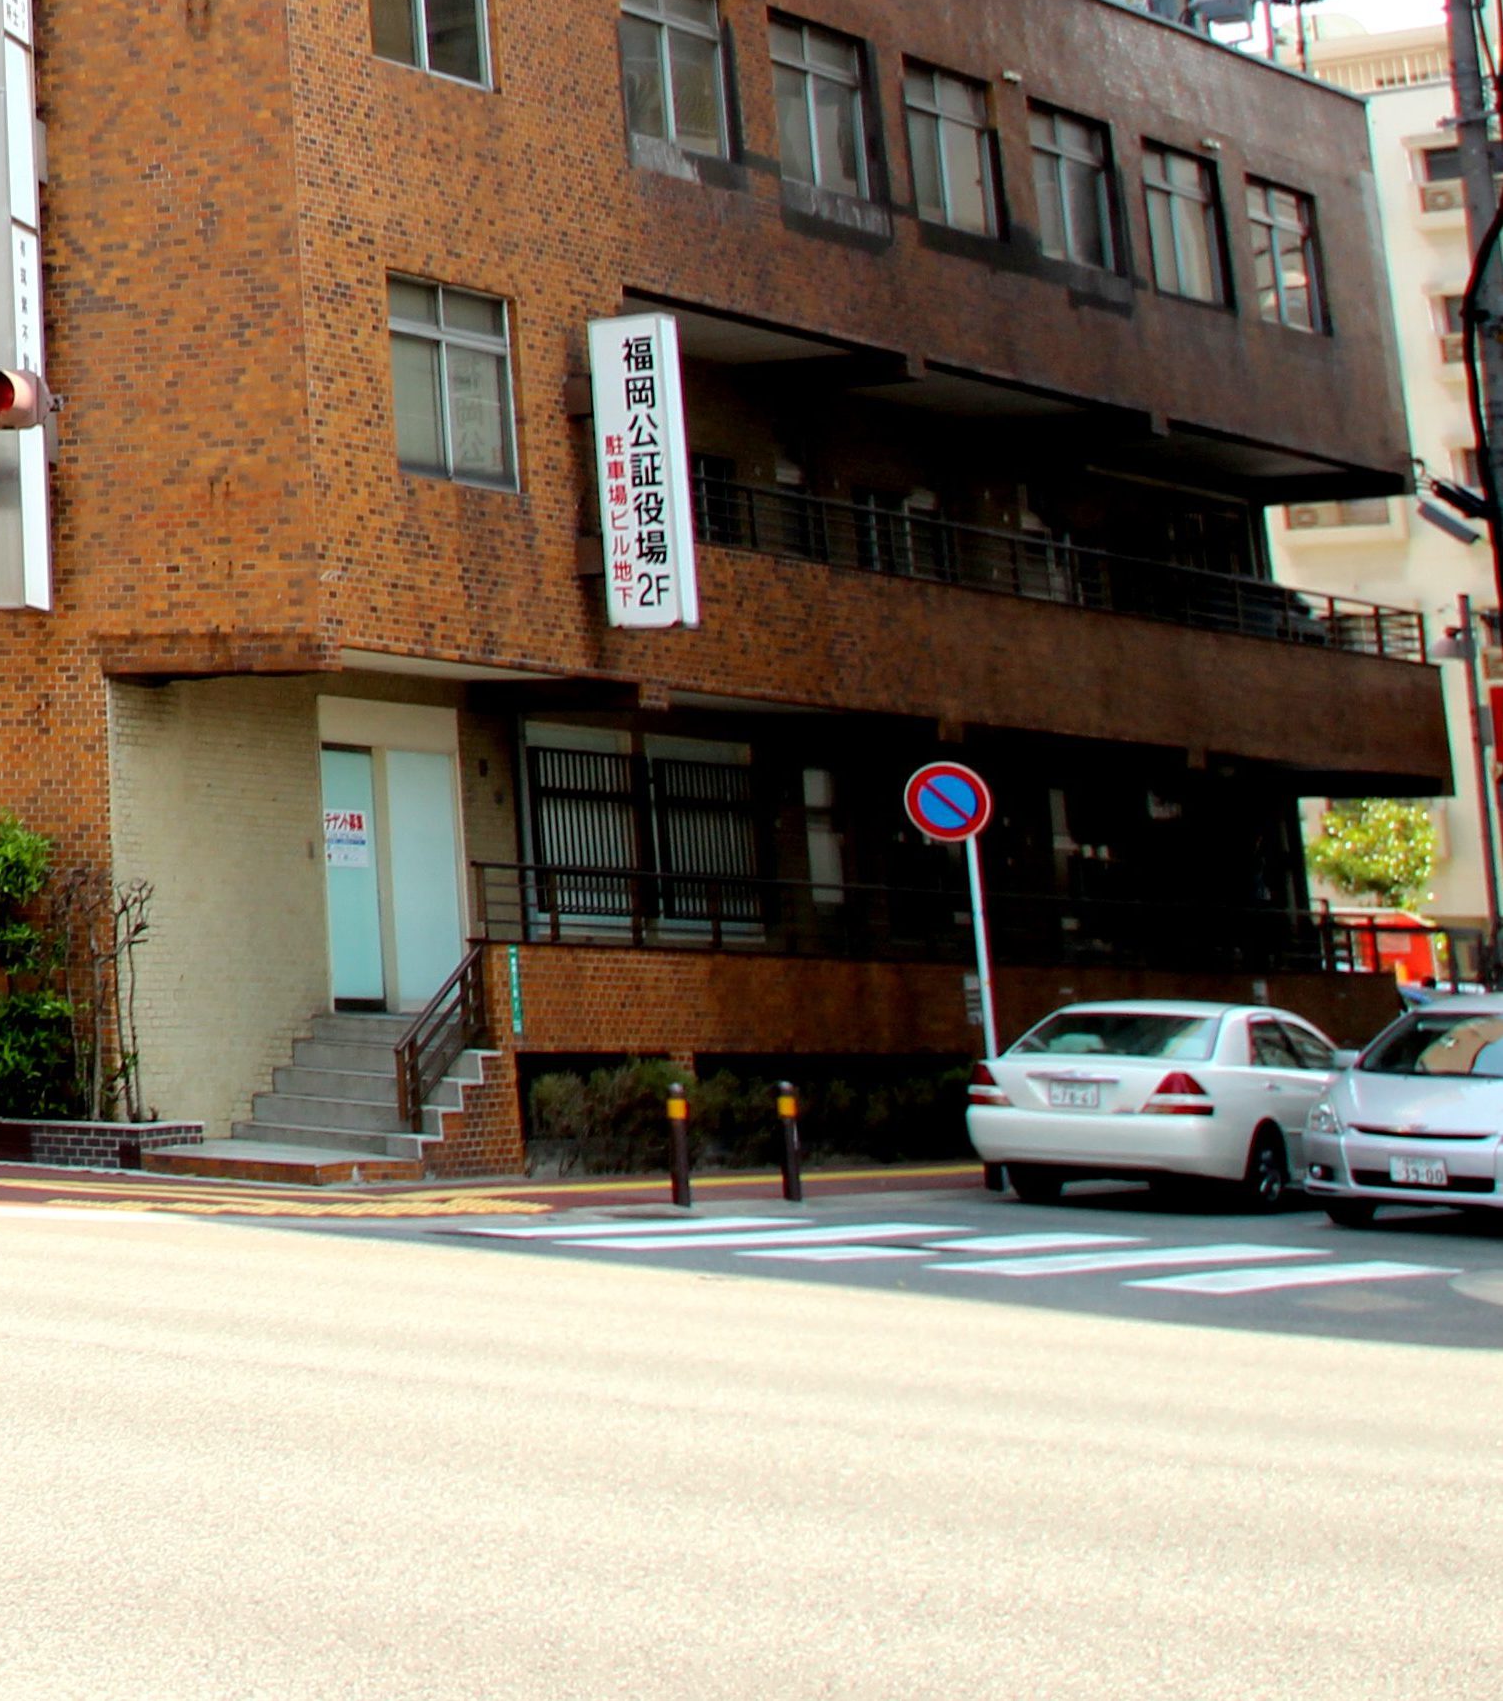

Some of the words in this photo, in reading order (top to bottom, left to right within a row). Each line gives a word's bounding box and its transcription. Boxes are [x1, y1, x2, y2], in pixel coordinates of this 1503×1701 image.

[605, 434, 634, 609] 駐車場ビル地下
